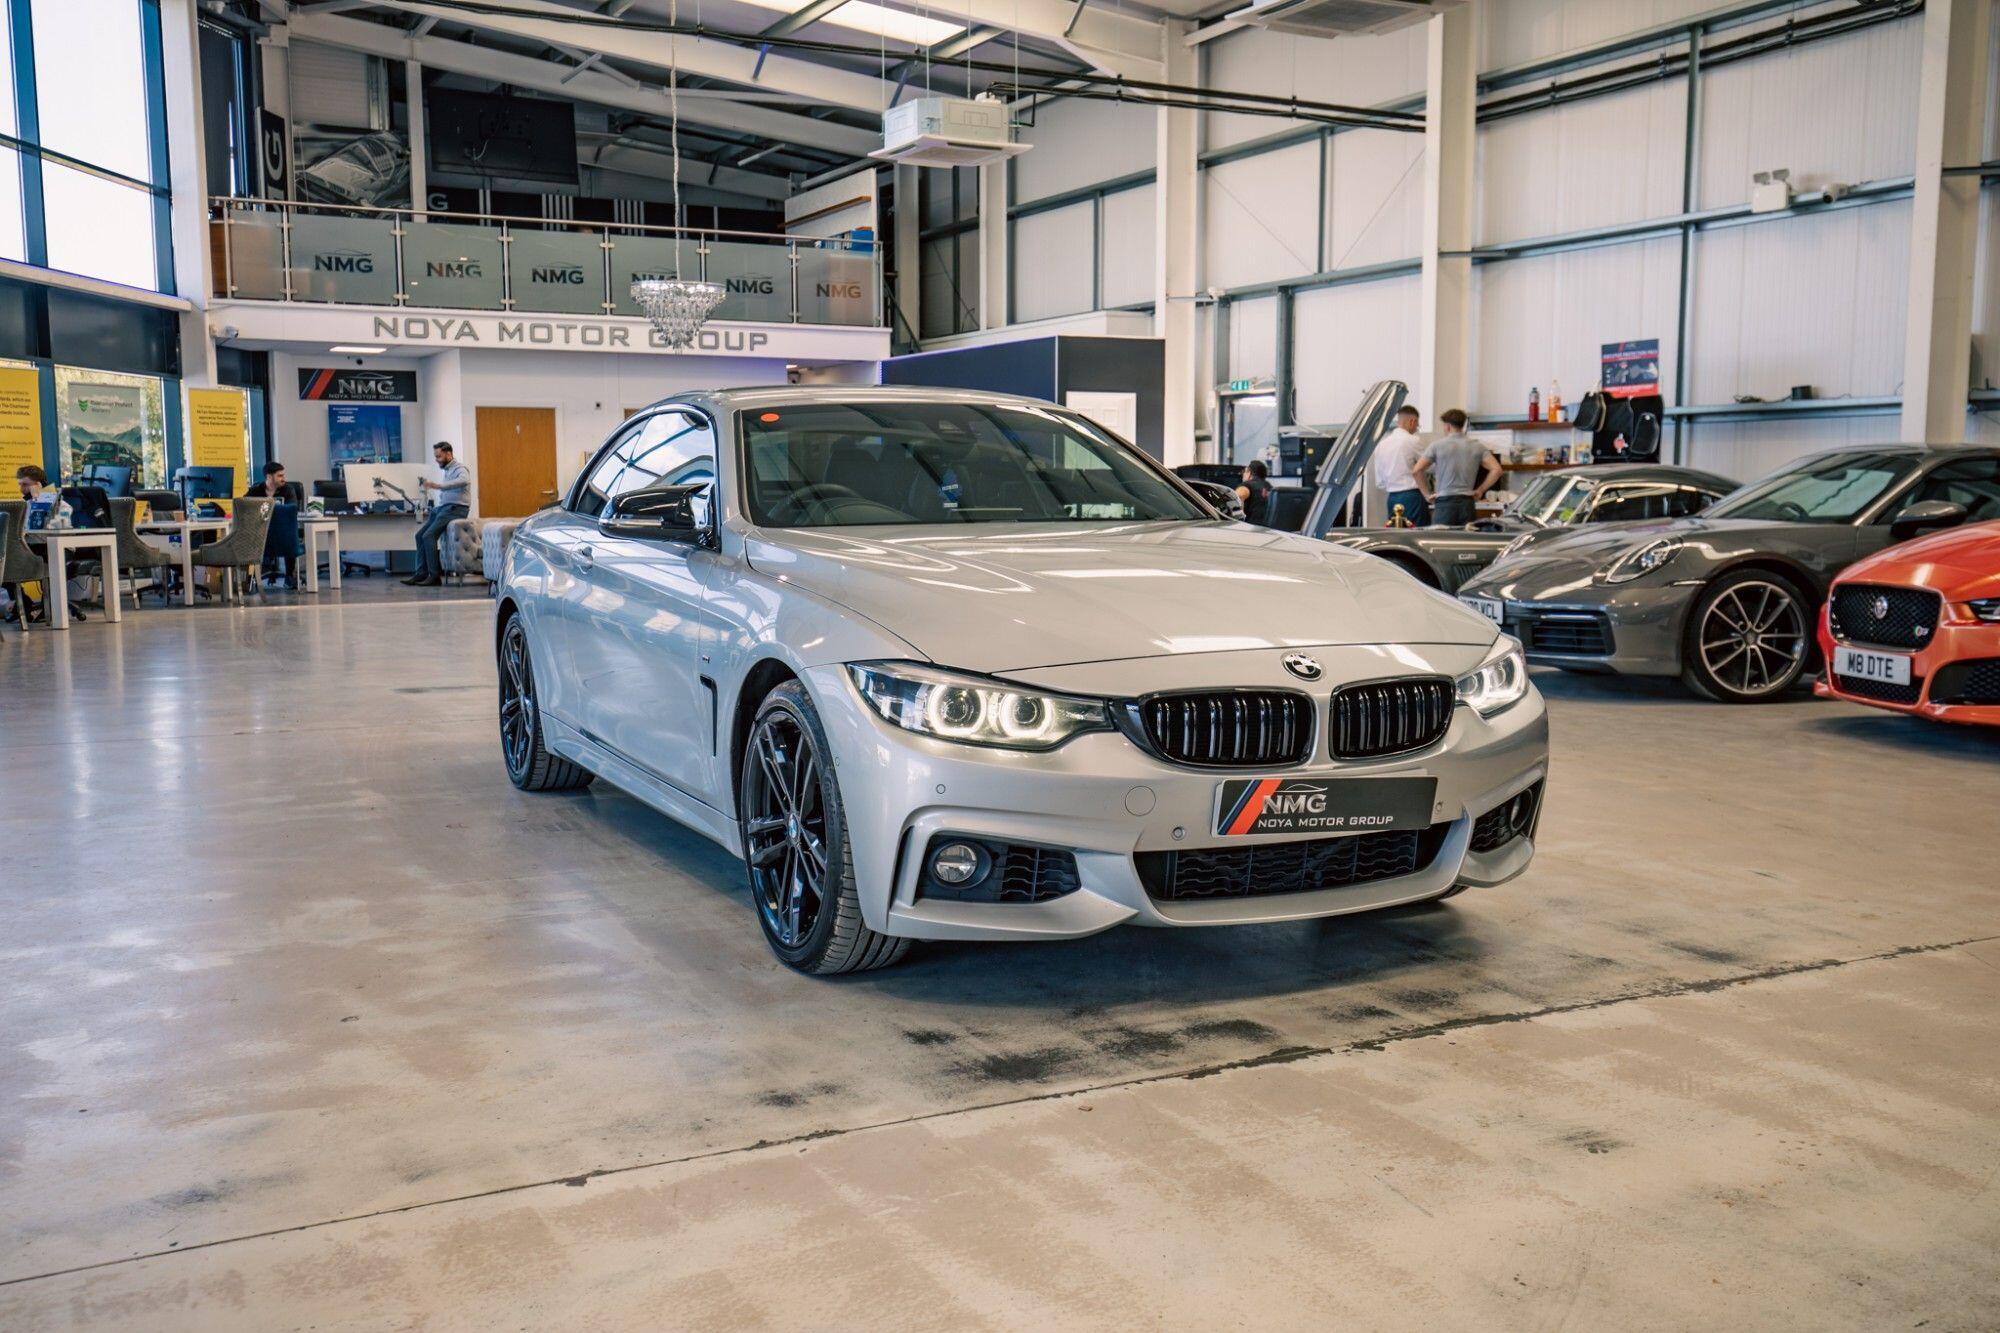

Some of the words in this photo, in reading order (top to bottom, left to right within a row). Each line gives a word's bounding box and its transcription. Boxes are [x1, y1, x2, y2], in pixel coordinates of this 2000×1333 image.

[315, 254, 374, 274] NMG
[426, 261, 482, 279] NMG
[532, 267, 584, 285] NMG
[726, 278, 774, 295] NMG
[816, 283, 862, 299] NMG
[374, 316, 479, 341] NOYA
[498, 321, 630, 347] MOTOR
[648, 328, 768, 351] GOUP
[338, 379, 395, 394] NMG
[1848, 652, 1864, 673] M8
[1867, 655, 1894, 679] DTE
[1261, 793, 1327, 814] NMG
[1257, 817, 1293, 828] NOYA
[1299, 816, 1344, 827] MOTOR
[1349, 815, 1394, 826] GROUP
